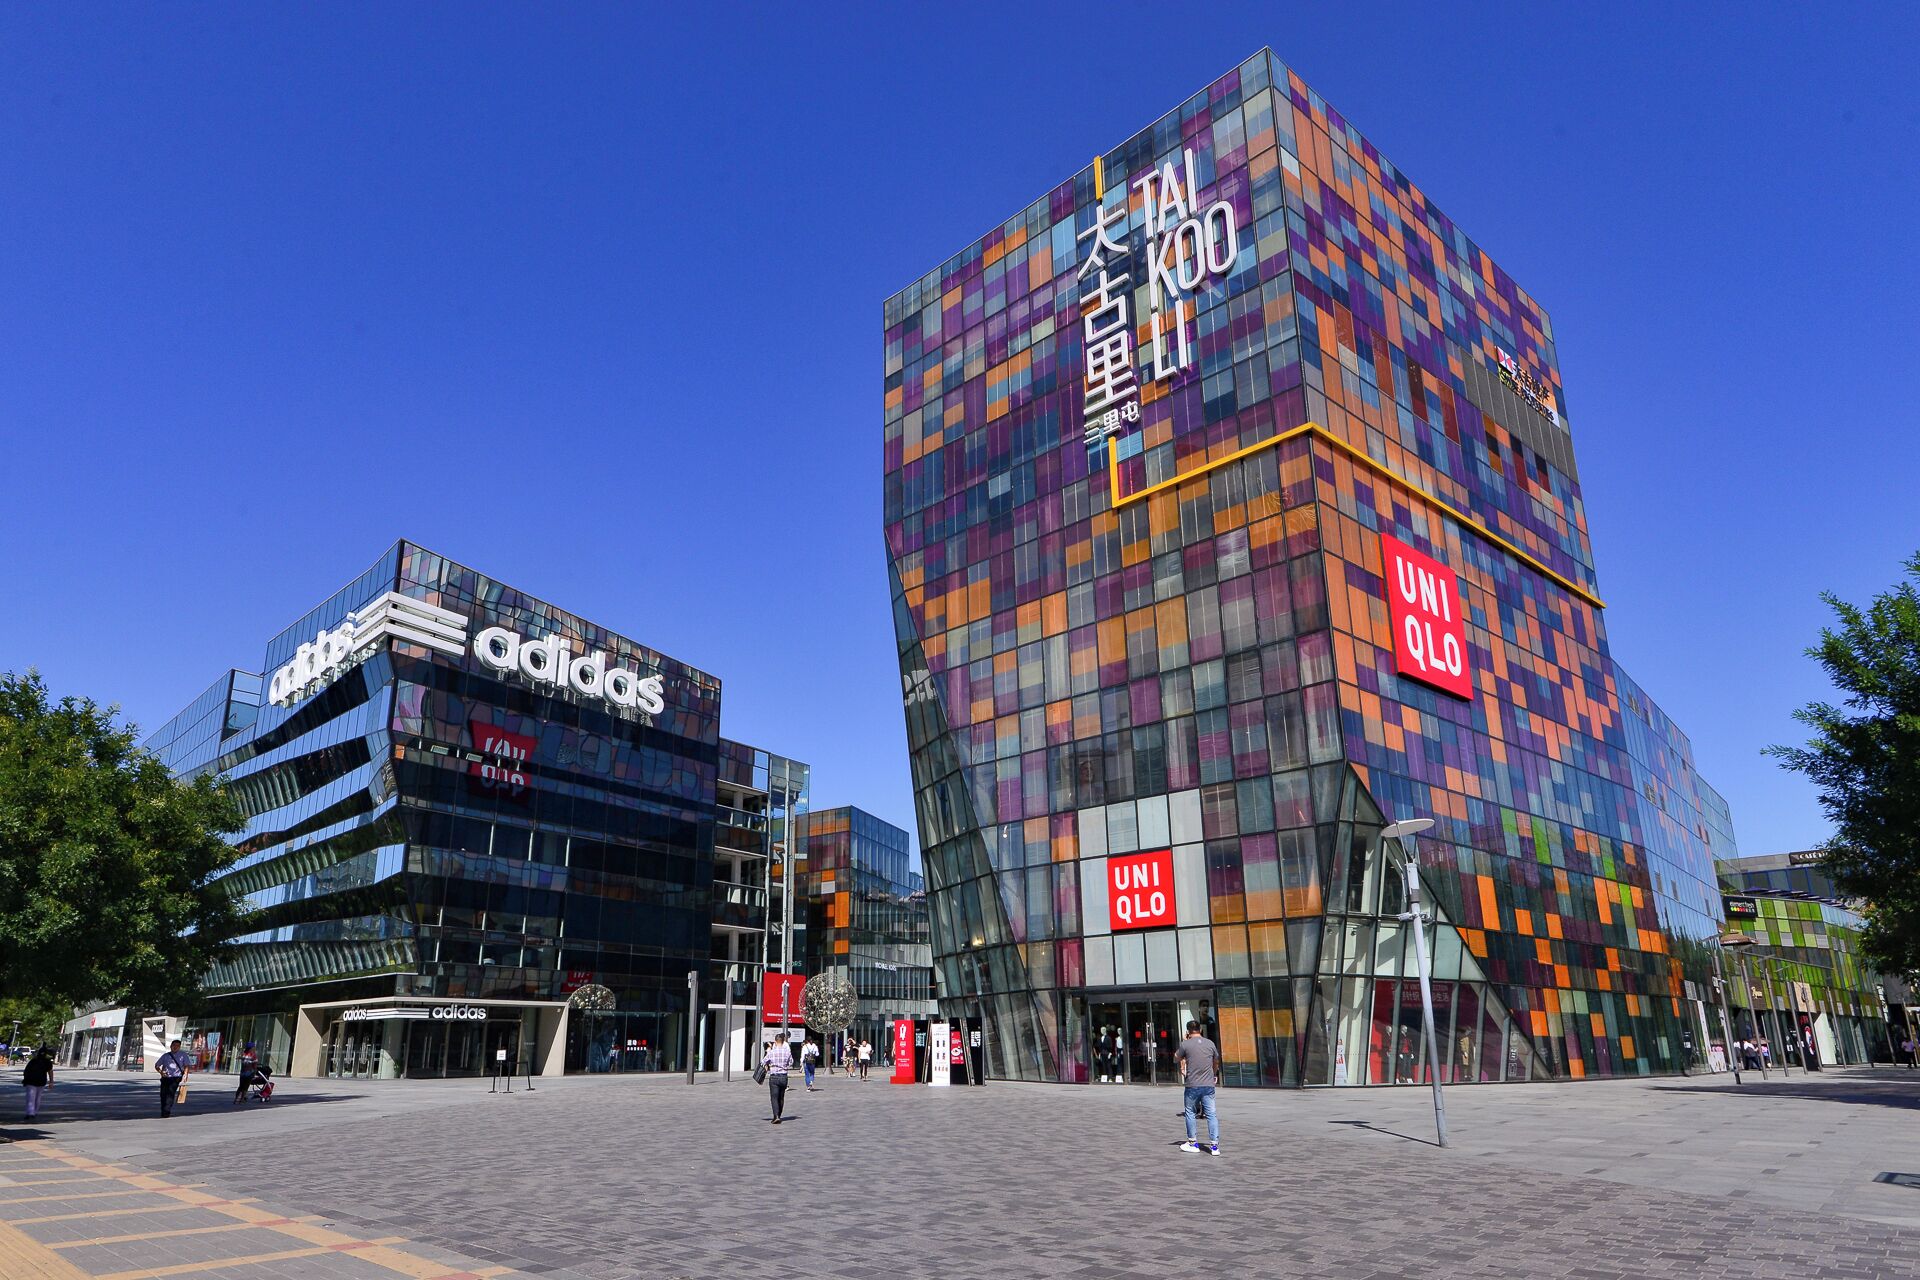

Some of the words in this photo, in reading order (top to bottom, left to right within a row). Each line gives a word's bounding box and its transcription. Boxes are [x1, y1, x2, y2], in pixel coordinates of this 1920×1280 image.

[1133, 148, 1198, 240] TAI
[1147, 201, 1238, 309] KOO
[1077, 205, 1138, 416] 太古里
[1151, 299, 1188, 380] LI
[1083, 400, 1139, 444] 三里屯
[1396, 555, 1451, 622] UNI
[269, 621, 354, 705] adidas
[474, 626, 665, 715] adidas
[1404, 614, 1462, 677] QLO
[1115, 861, 1159, 890] UNI
[1116, 891, 1166, 923] QLO
[343, 1005, 367, 1021] adidas
[432, 1004, 487, 1020] adidas
